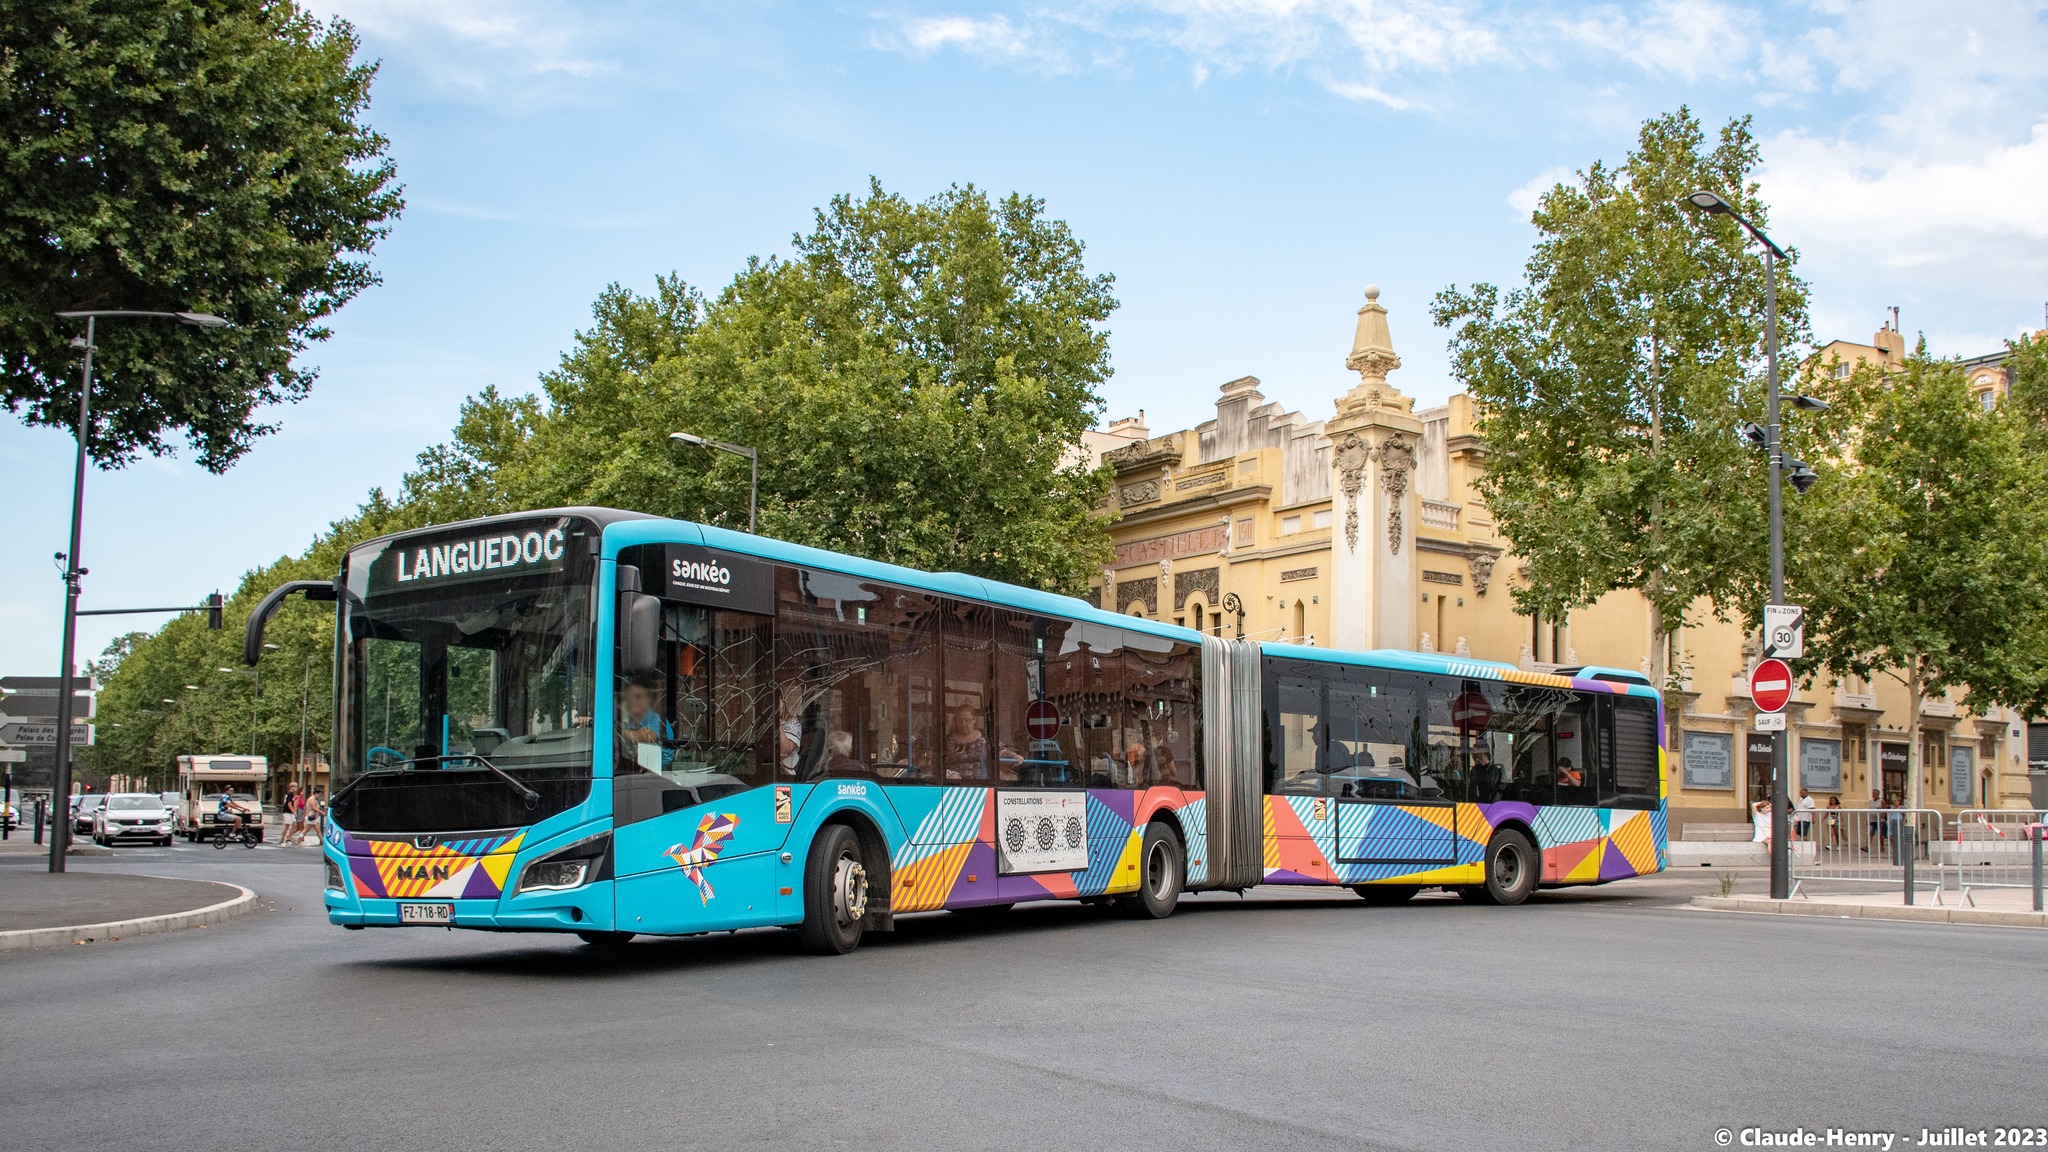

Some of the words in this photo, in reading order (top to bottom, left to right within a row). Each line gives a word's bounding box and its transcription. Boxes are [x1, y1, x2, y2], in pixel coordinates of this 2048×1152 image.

[1238, 523, 1253, 541] 1911
[398, 528, 564, 582] LANGUEDOC
[673, 559, 730, 585] sankéo
[1776, 632, 1791, 643] 30
[837, 782, 867, 796] sankéo
[1003, 797, 1043, 806] CONSTELLATIONS
[397, 864, 450, 880] MAN
[403, 905, 448, 919] FZ-718-RD
